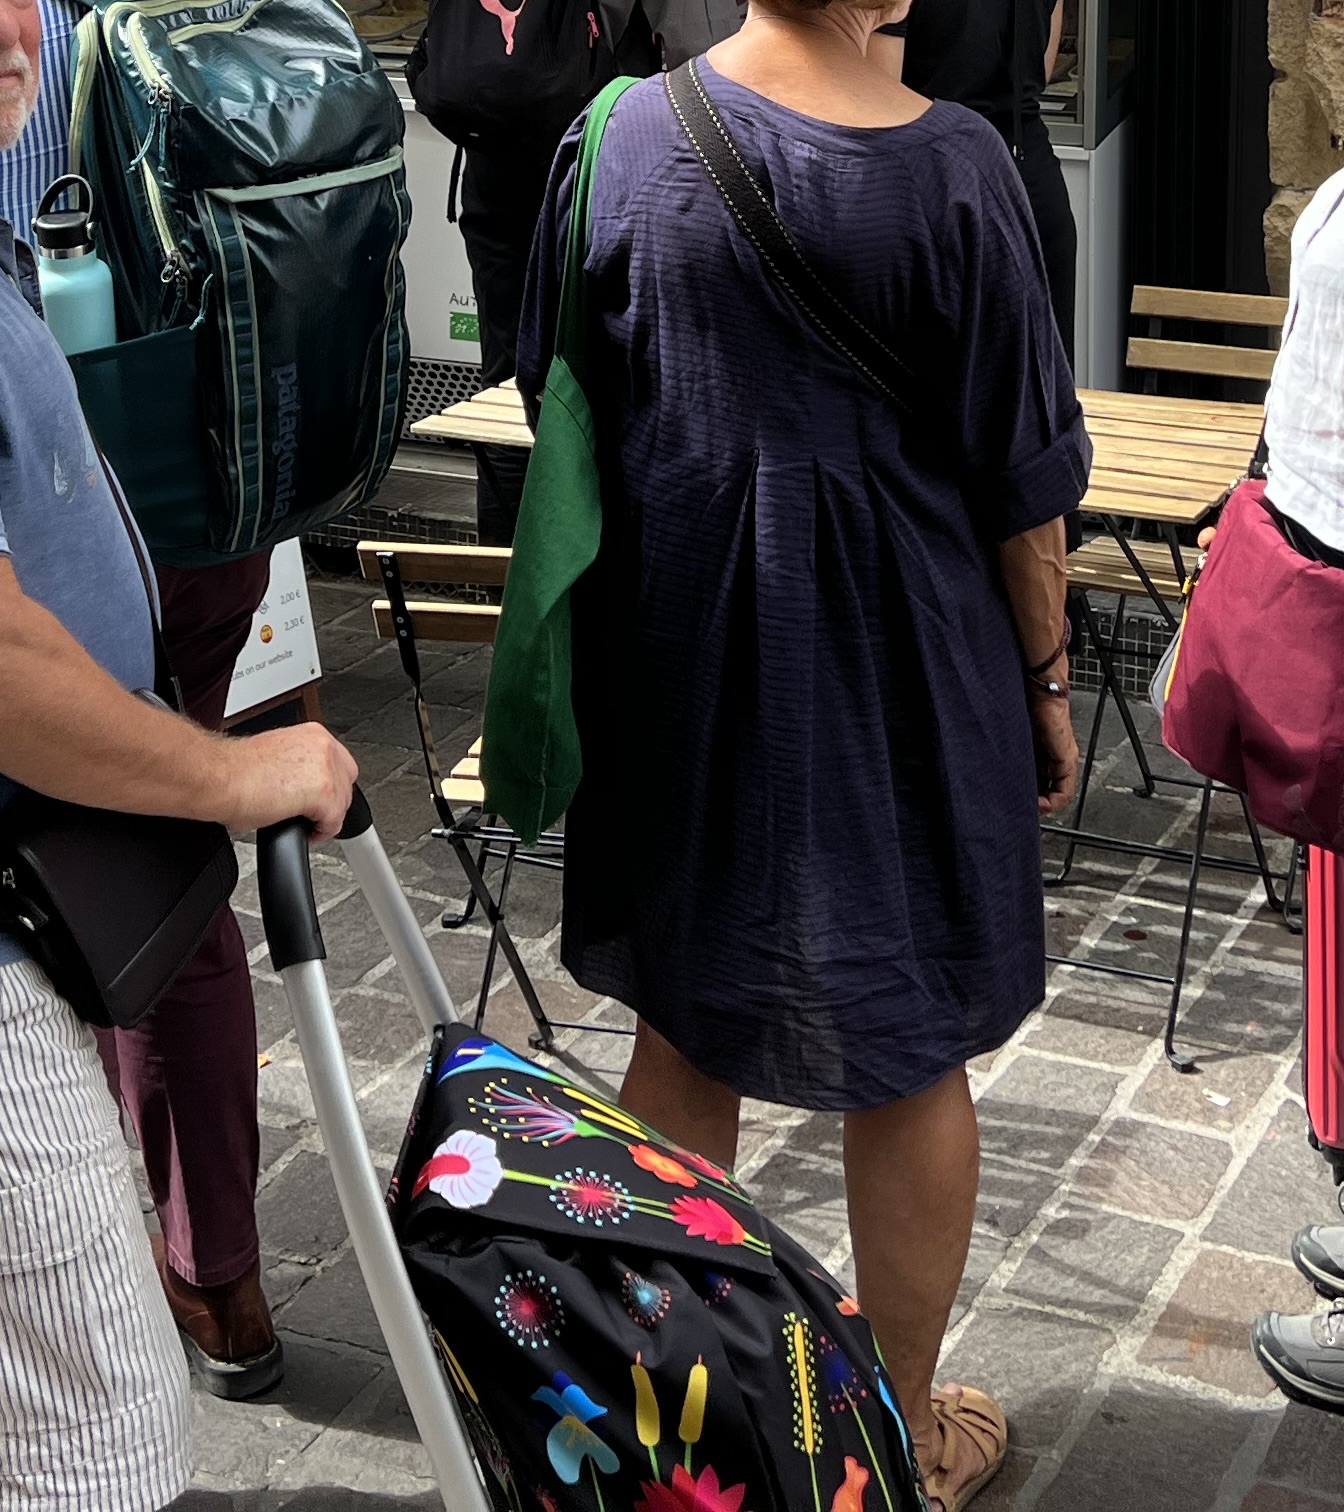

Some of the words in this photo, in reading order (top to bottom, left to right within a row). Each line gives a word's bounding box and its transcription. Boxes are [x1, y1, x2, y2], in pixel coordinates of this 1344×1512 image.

[271, 362, 301, 521] patagonia
[295, 589, 301, 598] €
[299, 615, 305, 625] €
[245, 666, 255, 676] on
[267, 650, 293, 666] website
